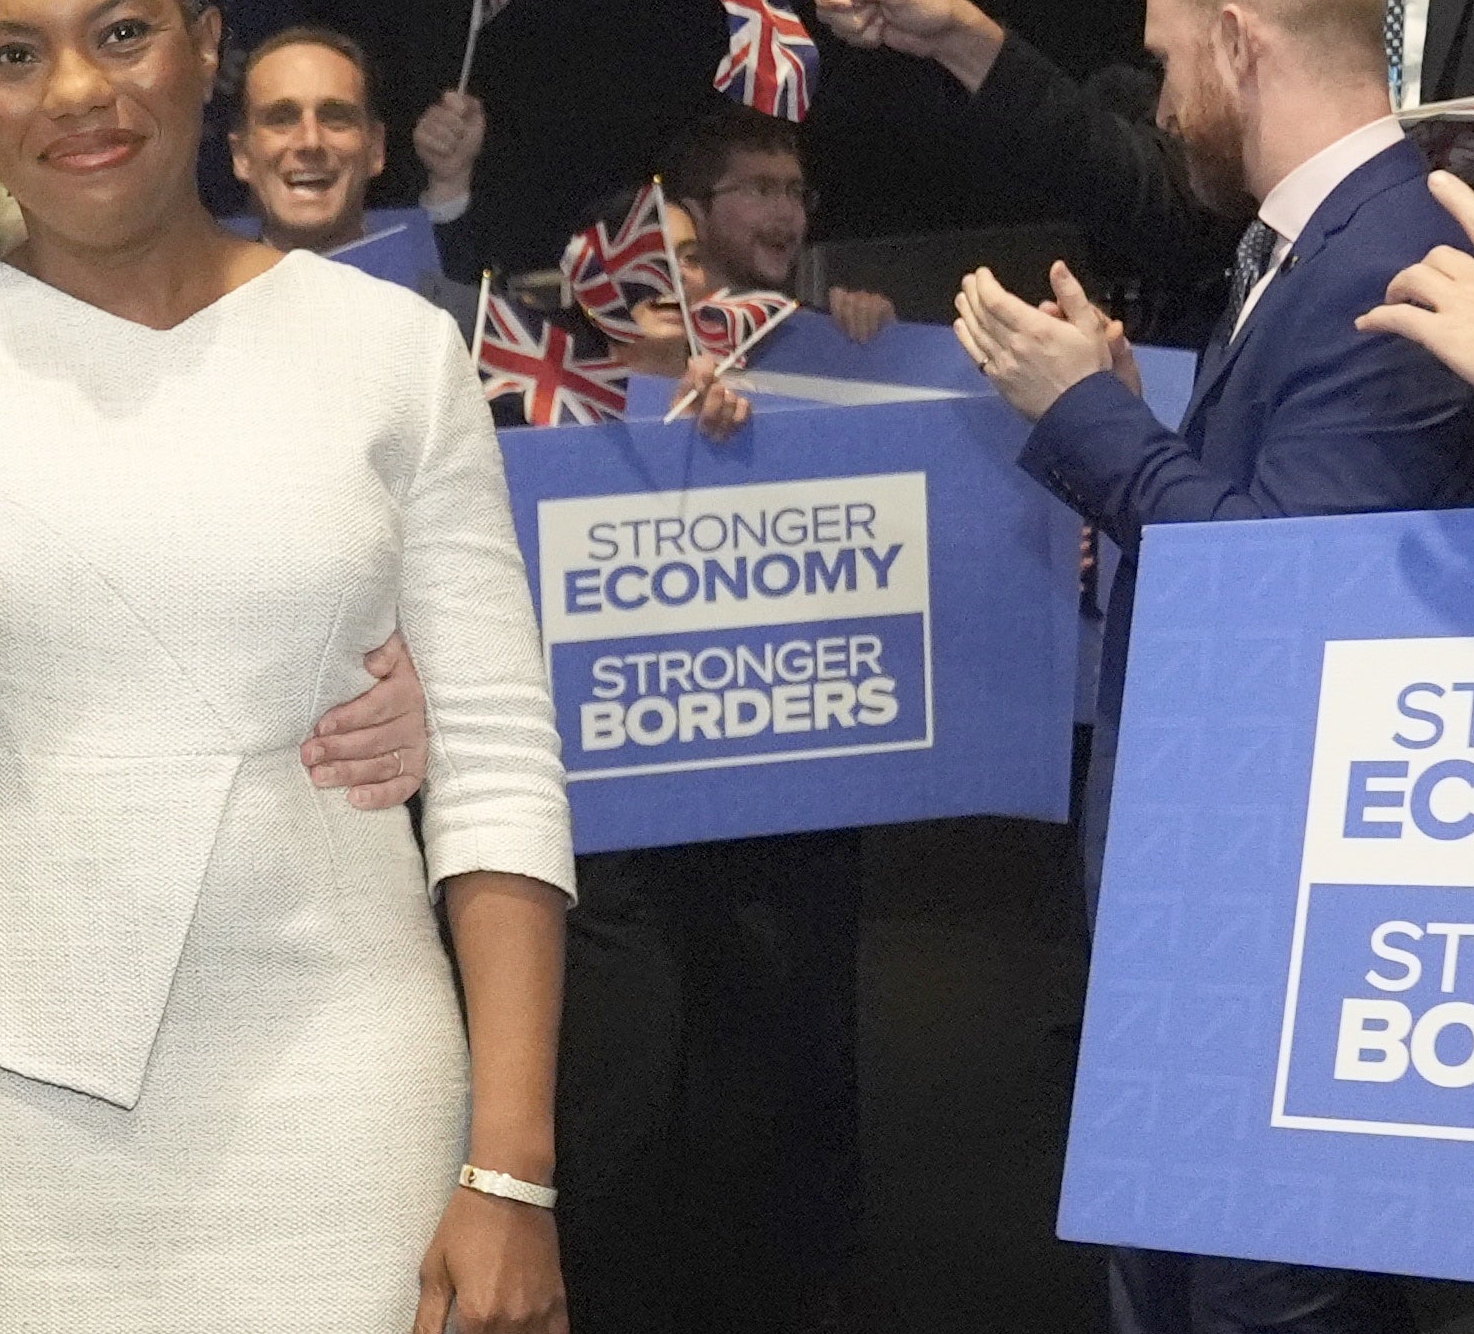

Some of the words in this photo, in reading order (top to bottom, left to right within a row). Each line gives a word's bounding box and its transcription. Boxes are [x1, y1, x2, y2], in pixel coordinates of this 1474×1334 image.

[587, 502, 877, 562] STRONGER
[563, 543, 904, 616] ECONOMY
[591, 634, 884, 699] STRONGER
[579, 675, 900, 752] BORDERS
